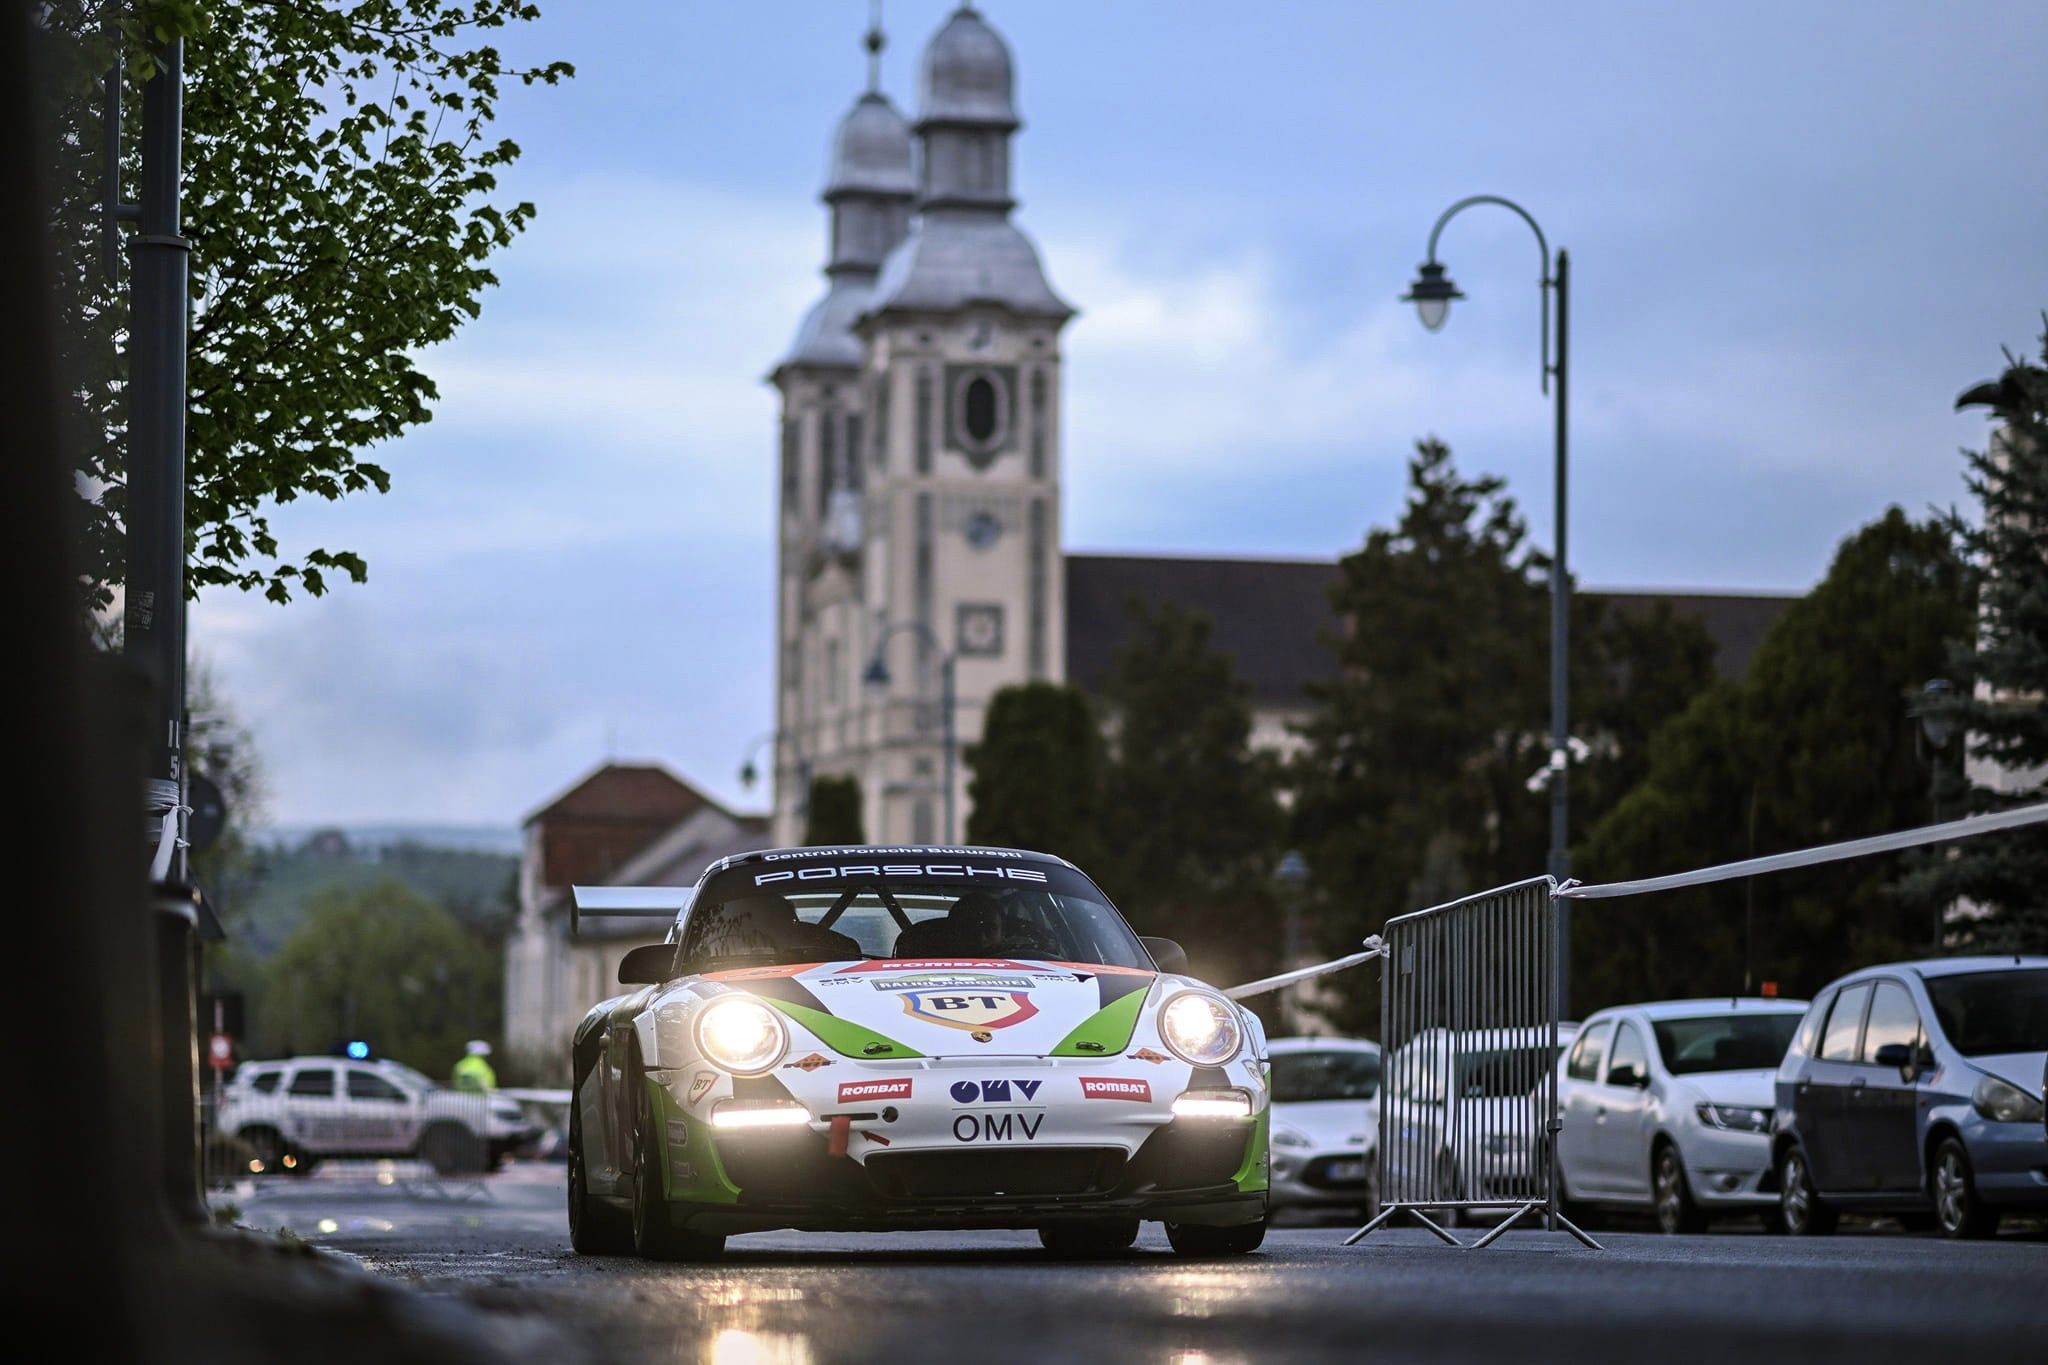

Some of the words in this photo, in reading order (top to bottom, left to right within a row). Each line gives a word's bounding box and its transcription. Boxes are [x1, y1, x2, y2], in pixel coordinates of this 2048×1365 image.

[170, 755, 180, 783] 5
[763, 849, 838, 862] Centrul
[754, 865, 1048, 886] PORSCHE
[927, 996, 1006, 1010] BT
[693, 1079, 712, 1091] BT
[841, 1082, 909, 1097] ROMBAT
[1085, 1081, 1146, 1095] ROMBAT
[952, 1113, 1045, 1142] OMV
